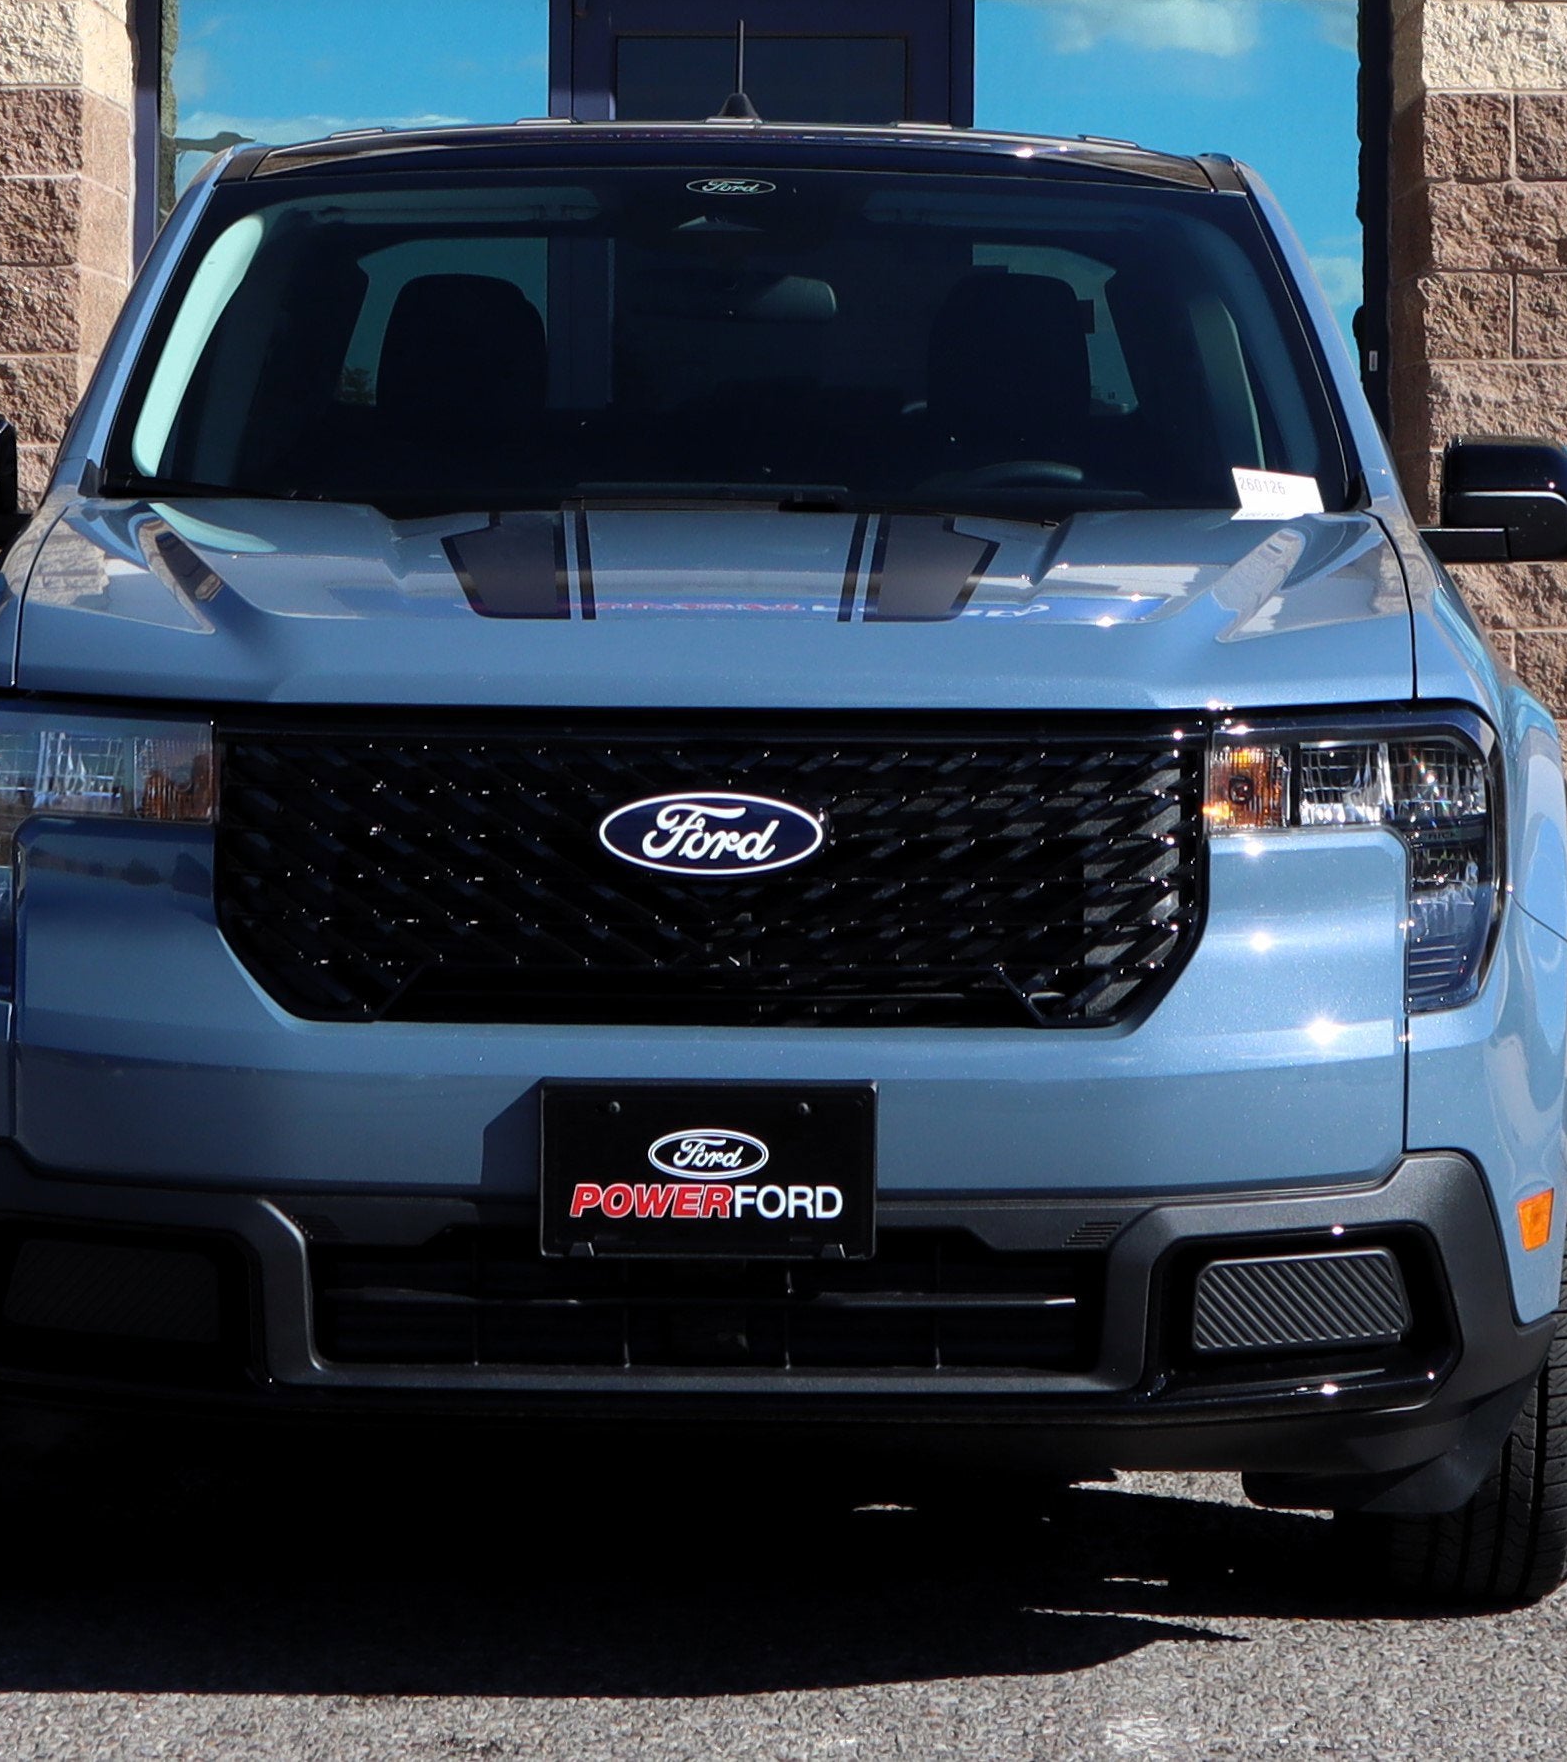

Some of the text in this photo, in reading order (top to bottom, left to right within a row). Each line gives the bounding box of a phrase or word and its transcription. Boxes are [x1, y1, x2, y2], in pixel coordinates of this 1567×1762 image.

[702, 179, 760, 194] Ford
[641, 802, 780, 861] Ford
[672, 1139, 743, 1170] Ford
[569, 1182, 844, 1220] POWERFORD
